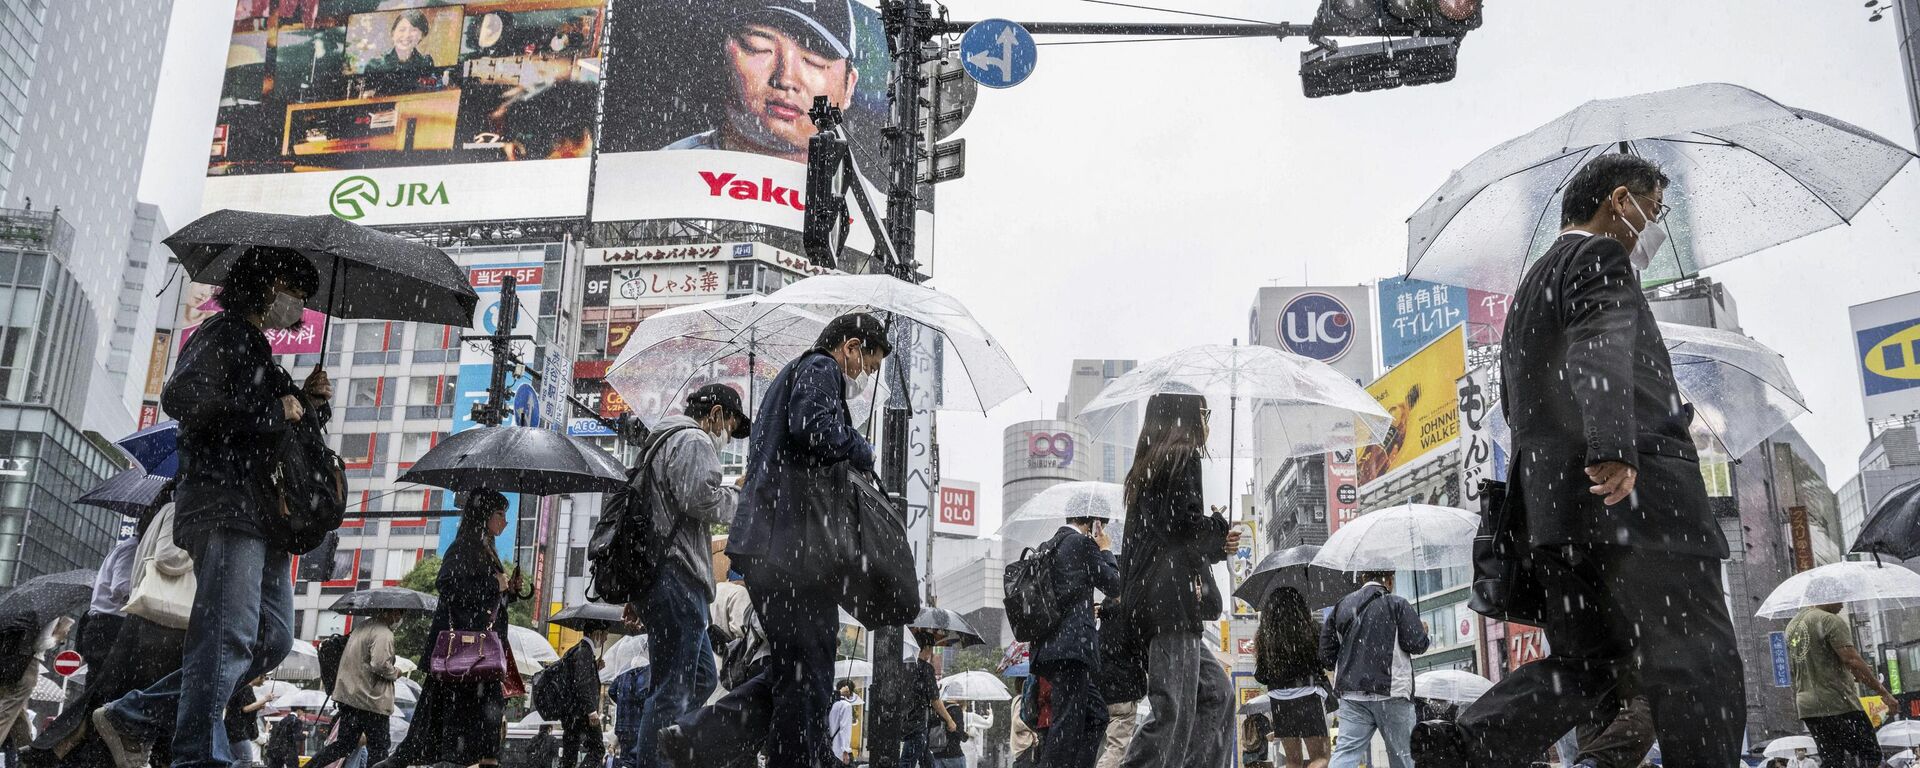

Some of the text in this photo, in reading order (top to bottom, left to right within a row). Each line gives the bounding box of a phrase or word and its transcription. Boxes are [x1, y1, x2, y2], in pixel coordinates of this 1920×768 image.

[386, 181, 450, 208] JRA
[602, 245, 722, 263] しゃぶしゃぶバイキング
[587, 280, 608, 294] 9F
[651, 271, 719, 293] しゃぶ葉
[1397, 284, 1449, 315] 龍角散
[1024, 432, 1074, 469] 109
[944, 491, 969, 506] UNI
[943, 506, 971, 522] QLO
